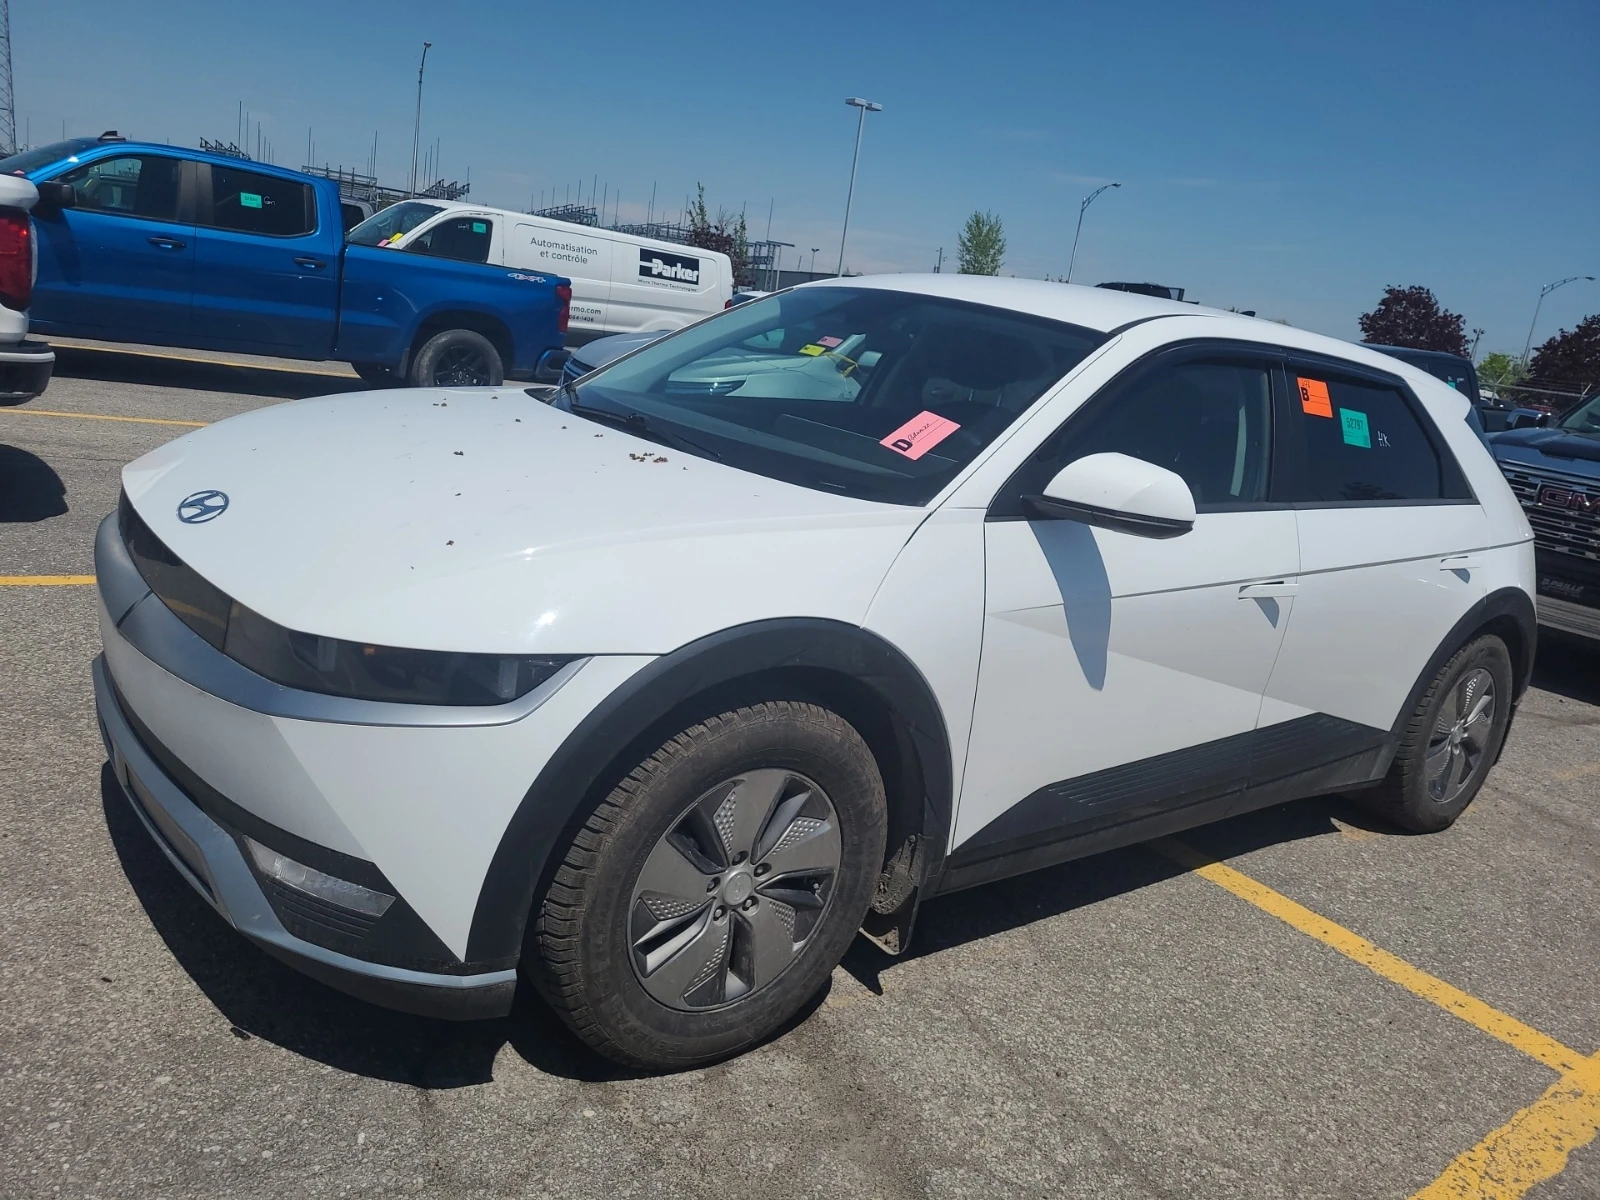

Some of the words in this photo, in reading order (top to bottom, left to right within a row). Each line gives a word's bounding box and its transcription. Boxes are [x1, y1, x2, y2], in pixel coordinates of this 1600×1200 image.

[530, 237, 598, 256] Automatisation
[540, 250, 549, 258] et
[551, 252, 588, 264] contrôle
[651, 258, 699, 282] Parker
[1301, 387, 1309, 401] B
[1346, 418, 1364, 431] 52797
[891, 438, 913, 453] D
